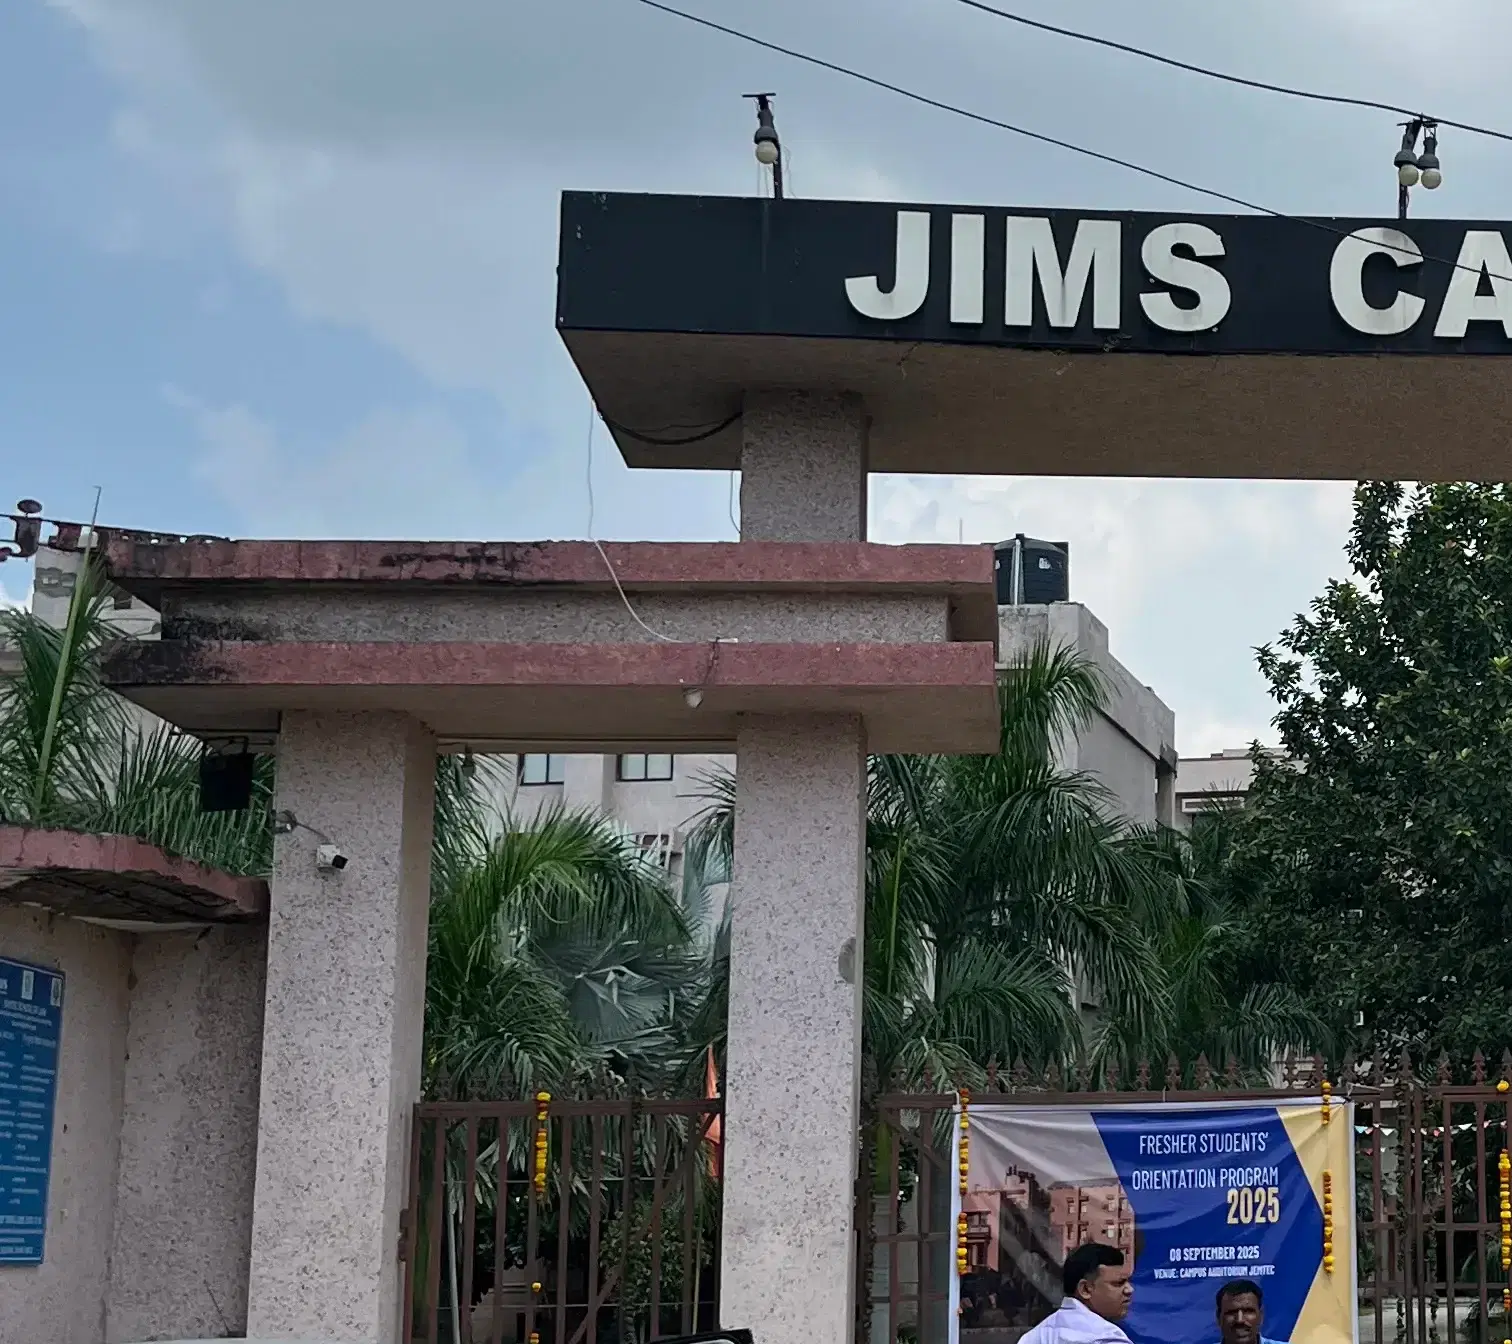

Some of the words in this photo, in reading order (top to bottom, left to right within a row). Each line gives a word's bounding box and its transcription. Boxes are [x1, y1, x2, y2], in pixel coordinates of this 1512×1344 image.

[845, 210, 1232, 333] JIMS
[1139, 1134, 1197, 1154] FRESHER
[1132, 1168, 1216, 1190] ORIENTATION
[1219, 1166, 1279, 1188] PROGRAM
[1227, 1186, 1280, 1224] 2025
[1169, 1248, 1182, 1262] 08
[1183, 1246, 1236, 1261] SEPTEMBER
[1237, 1245, 1260, 1259] 2025
[1180, 1266, 1207, 1278] CAMPUS
